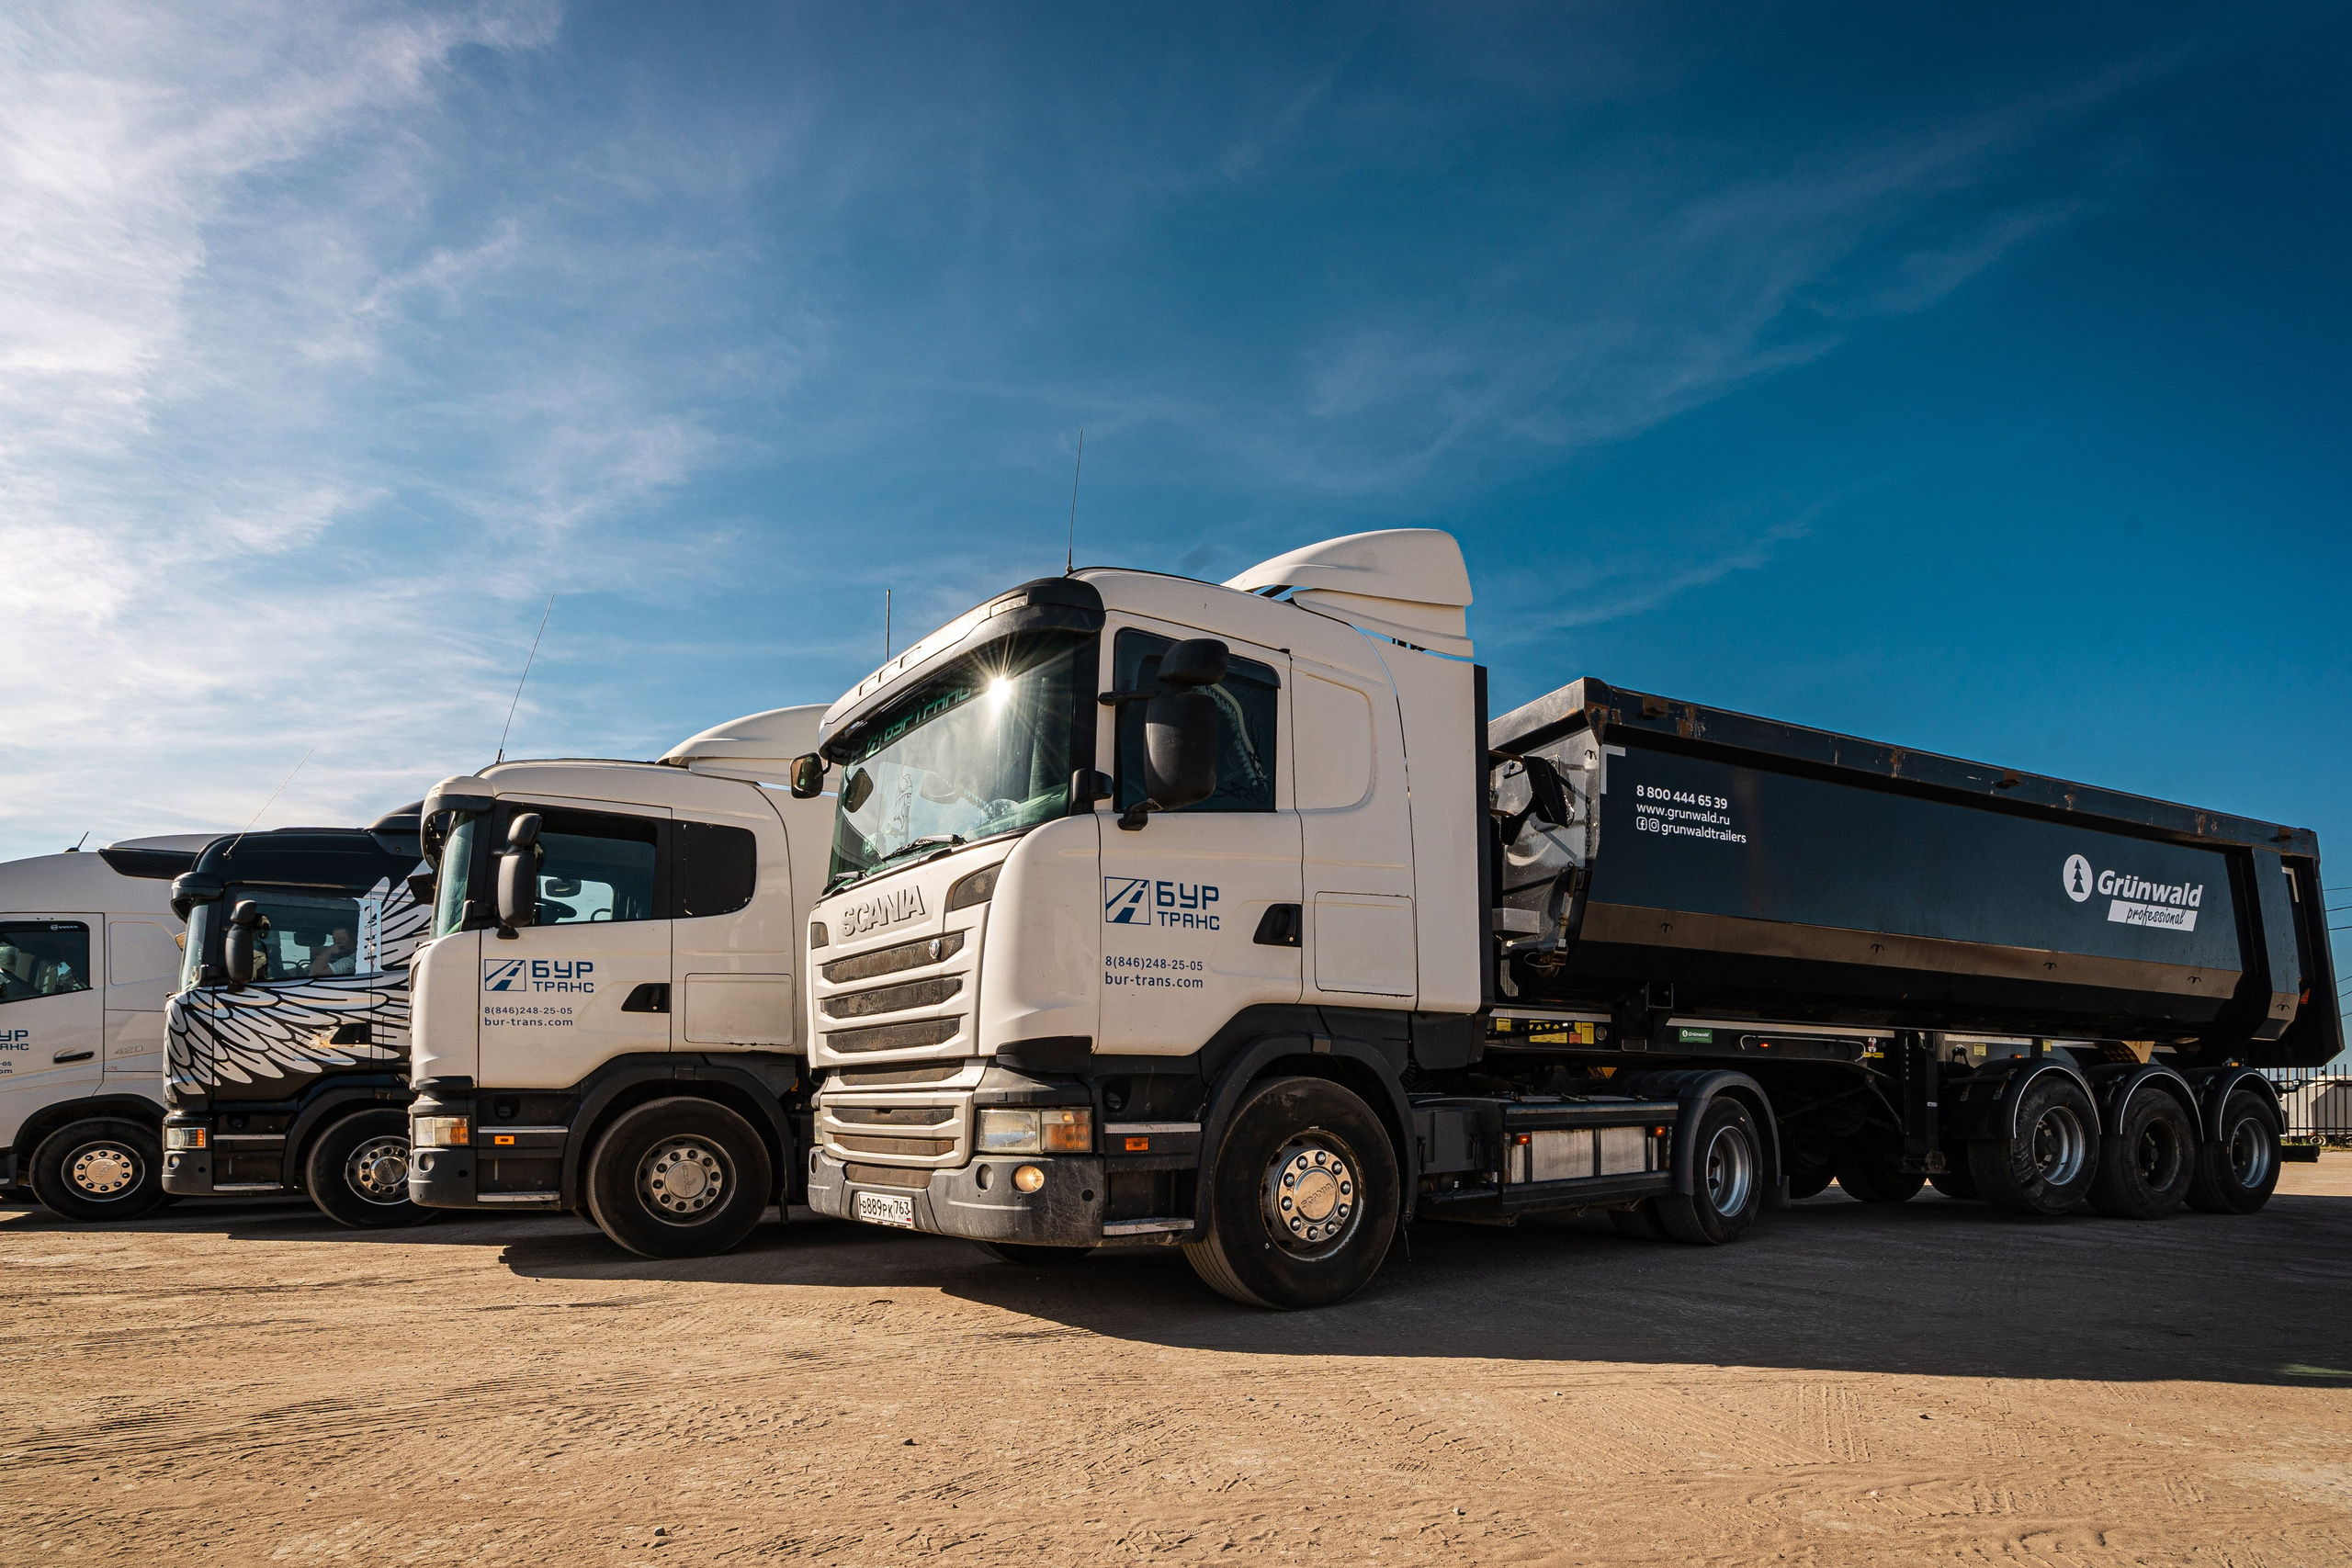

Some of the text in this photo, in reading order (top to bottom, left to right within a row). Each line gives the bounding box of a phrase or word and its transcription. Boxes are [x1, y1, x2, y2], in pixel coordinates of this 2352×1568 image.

[1636, 784, 1728, 809] 8 800 444 65 39
[1636, 803, 1730, 825] www.grunwald.ru
[1661, 823, 1747, 843] grunwaldtrailers
[1156, 880, 1219, 910] БУР
[2098, 870, 2203, 908] Grünwald
[841, 885, 926, 936] SCANIA
[1157, 910, 1220, 931] ТРАНС
[2126, 904, 2186, 926] professional
[532, 960, 594, 979] БУР
[1105, 955, 1204, 971] 8(846)248-25-05
[532, 981, 594, 993] ТРАНС
[1105, 971, 1204, 988] bur-trans.com
[484, 1006, 573, 1016] 8(846)248-25-05
[484, 1017, 573, 1026] bur-trans.com
[113, 1044, 143, 1055] 420
[1300, 1182, 1335, 1209] SCANIA
[894, 1201, 910, 1214] 763
